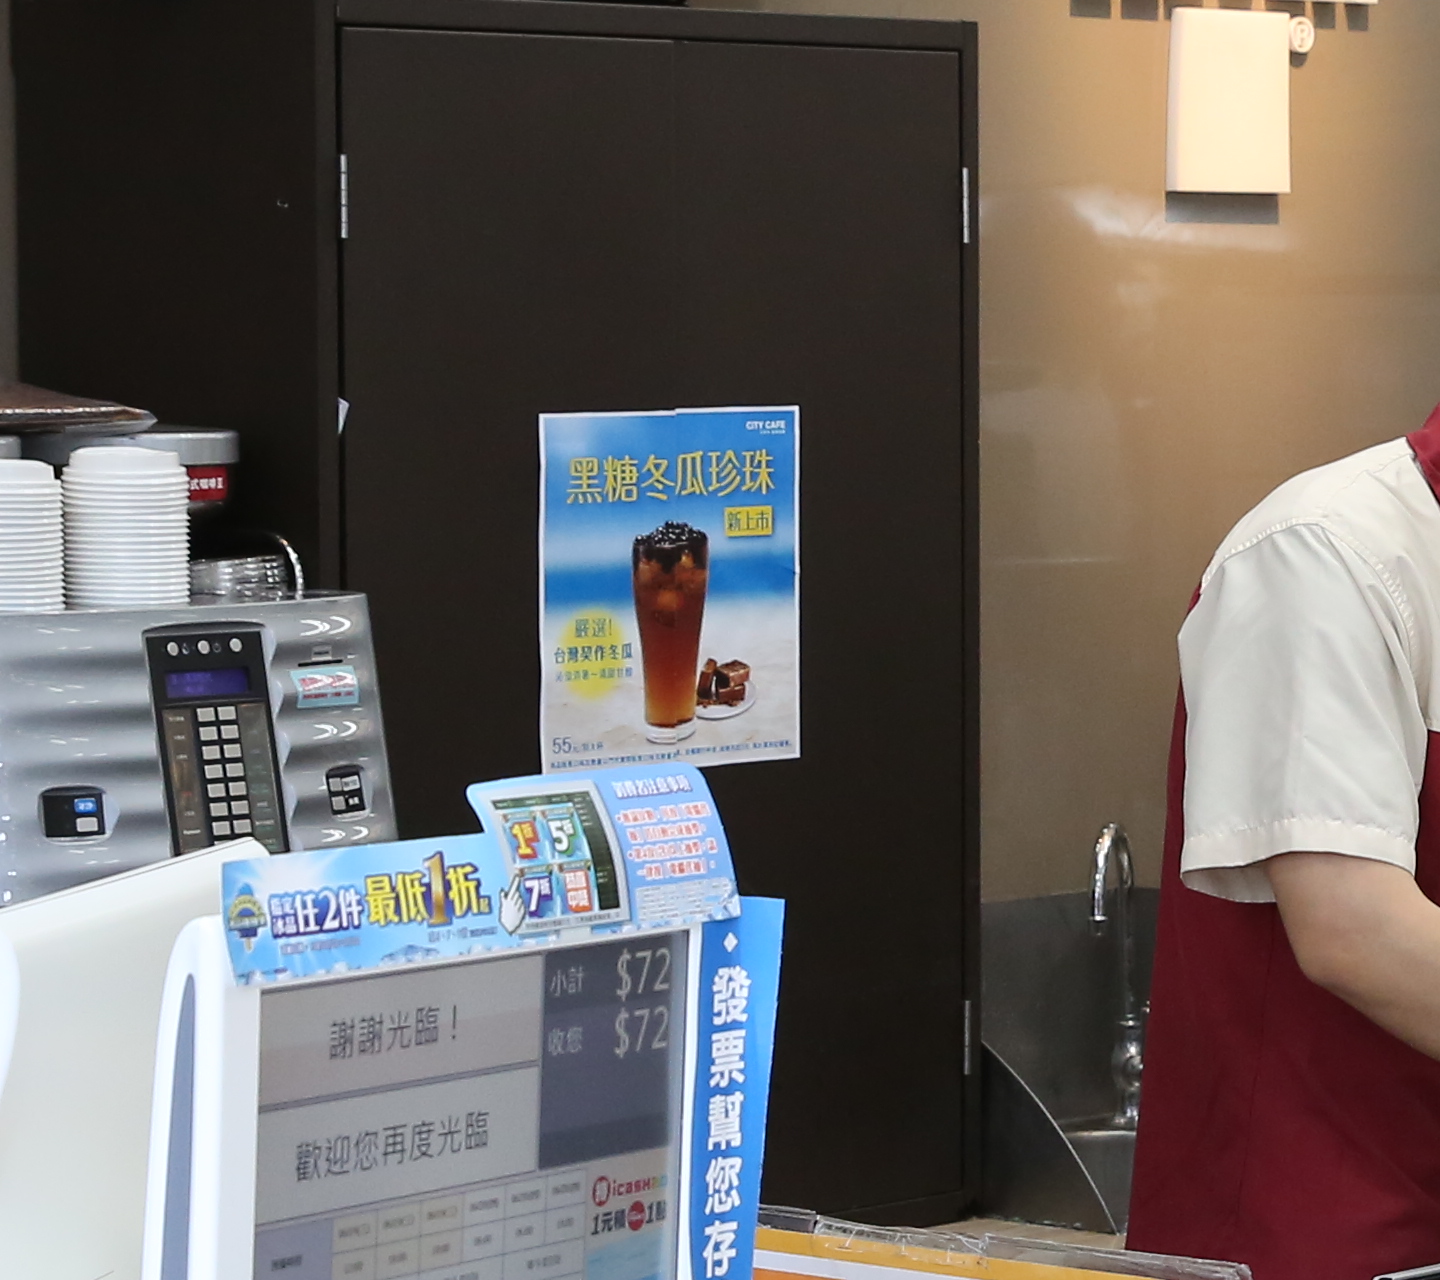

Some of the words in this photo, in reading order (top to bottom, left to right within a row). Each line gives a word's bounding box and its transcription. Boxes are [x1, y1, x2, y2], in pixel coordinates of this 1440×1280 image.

[746, 421, 764, 431] CITY
[766, 420, 786, 430] CAFE
[566, 449, 775, 505] 黑糖冬瓜珍珠
[726, 510, 771, 532] 新上市
[549, 965, 584, 994] 小計
[616, 948, 670, 999] $72
[548, 1026, 583, 1054] 收您
[614, 1009, 668, 1059] $72
[295, 1112, 489, 1184] 歡迎您再度光臨
